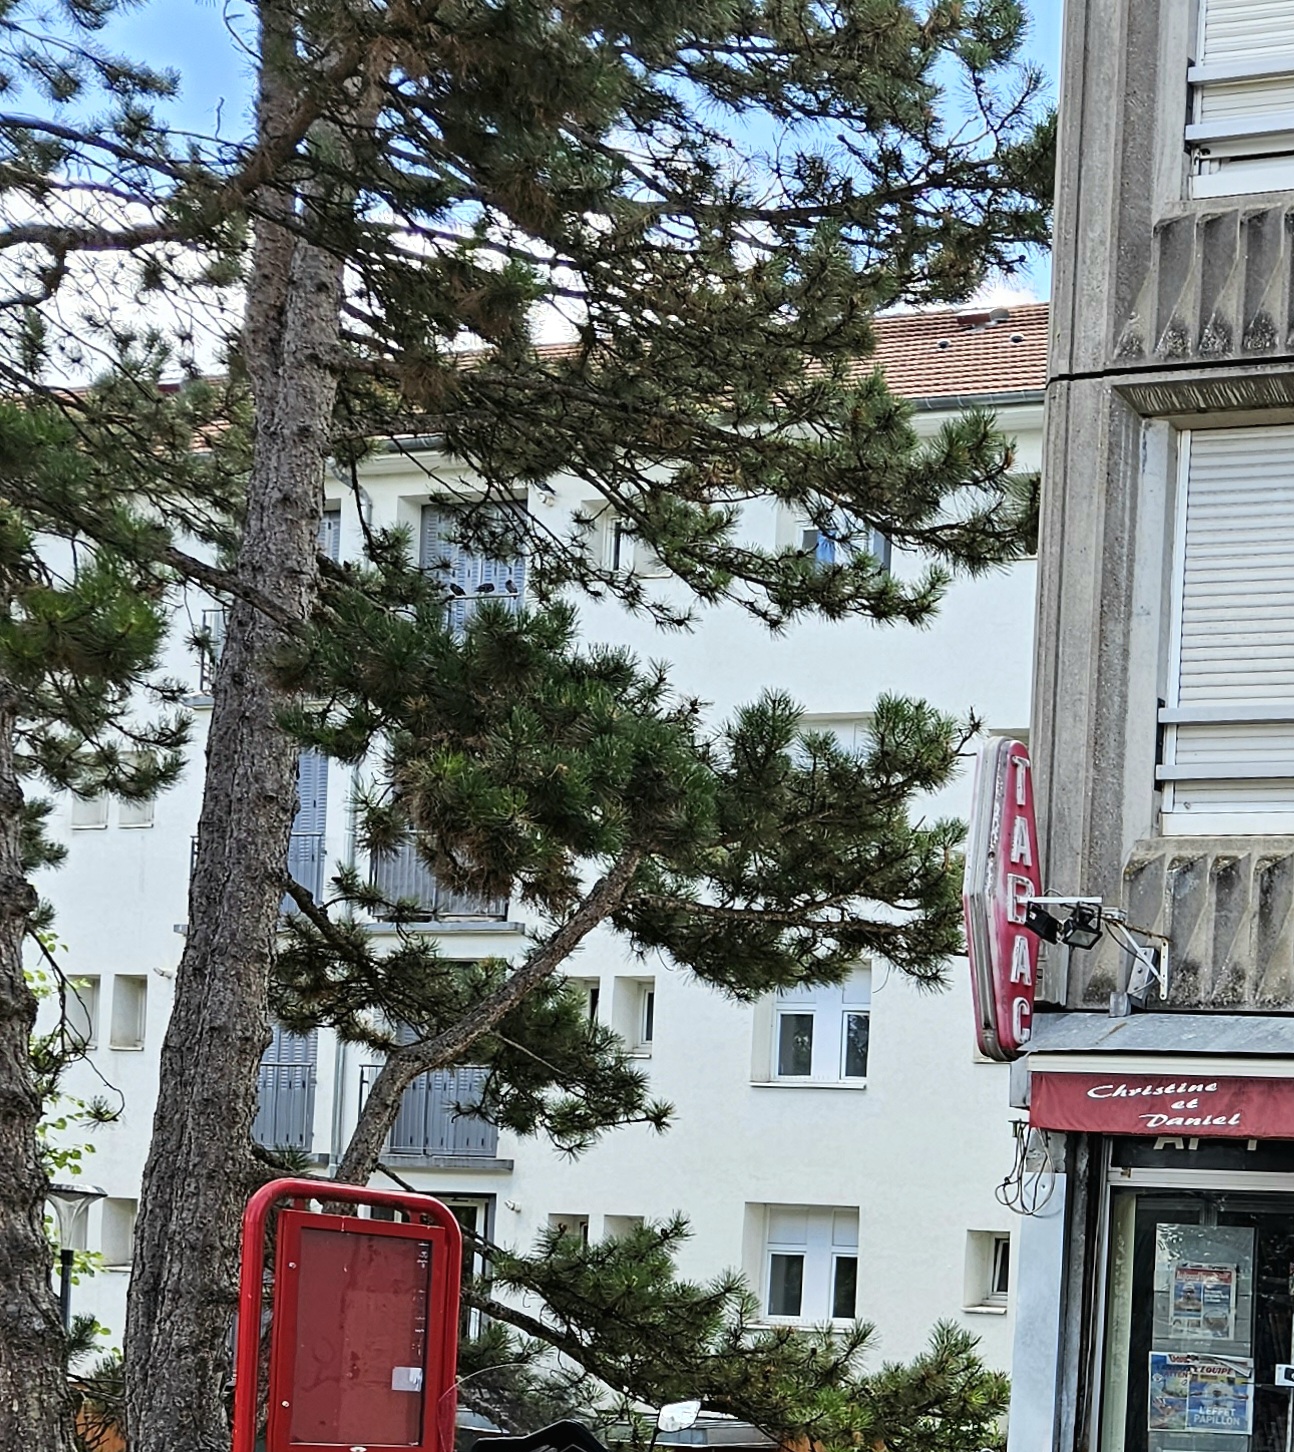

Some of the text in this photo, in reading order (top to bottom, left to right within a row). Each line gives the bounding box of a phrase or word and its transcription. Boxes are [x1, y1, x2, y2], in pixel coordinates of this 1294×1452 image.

[1007, 754, 1036, 1045] TABAC
[1087, 1081, 1219, 1099] Christine
[1170, 1097, 1199, 1109] et
[1138, 1112, 1240, 1129] Daniel
[1199, 1405, 1236, 1417] L'EFFET
[1193, 1414, 1240, 1426] PAPILLON
